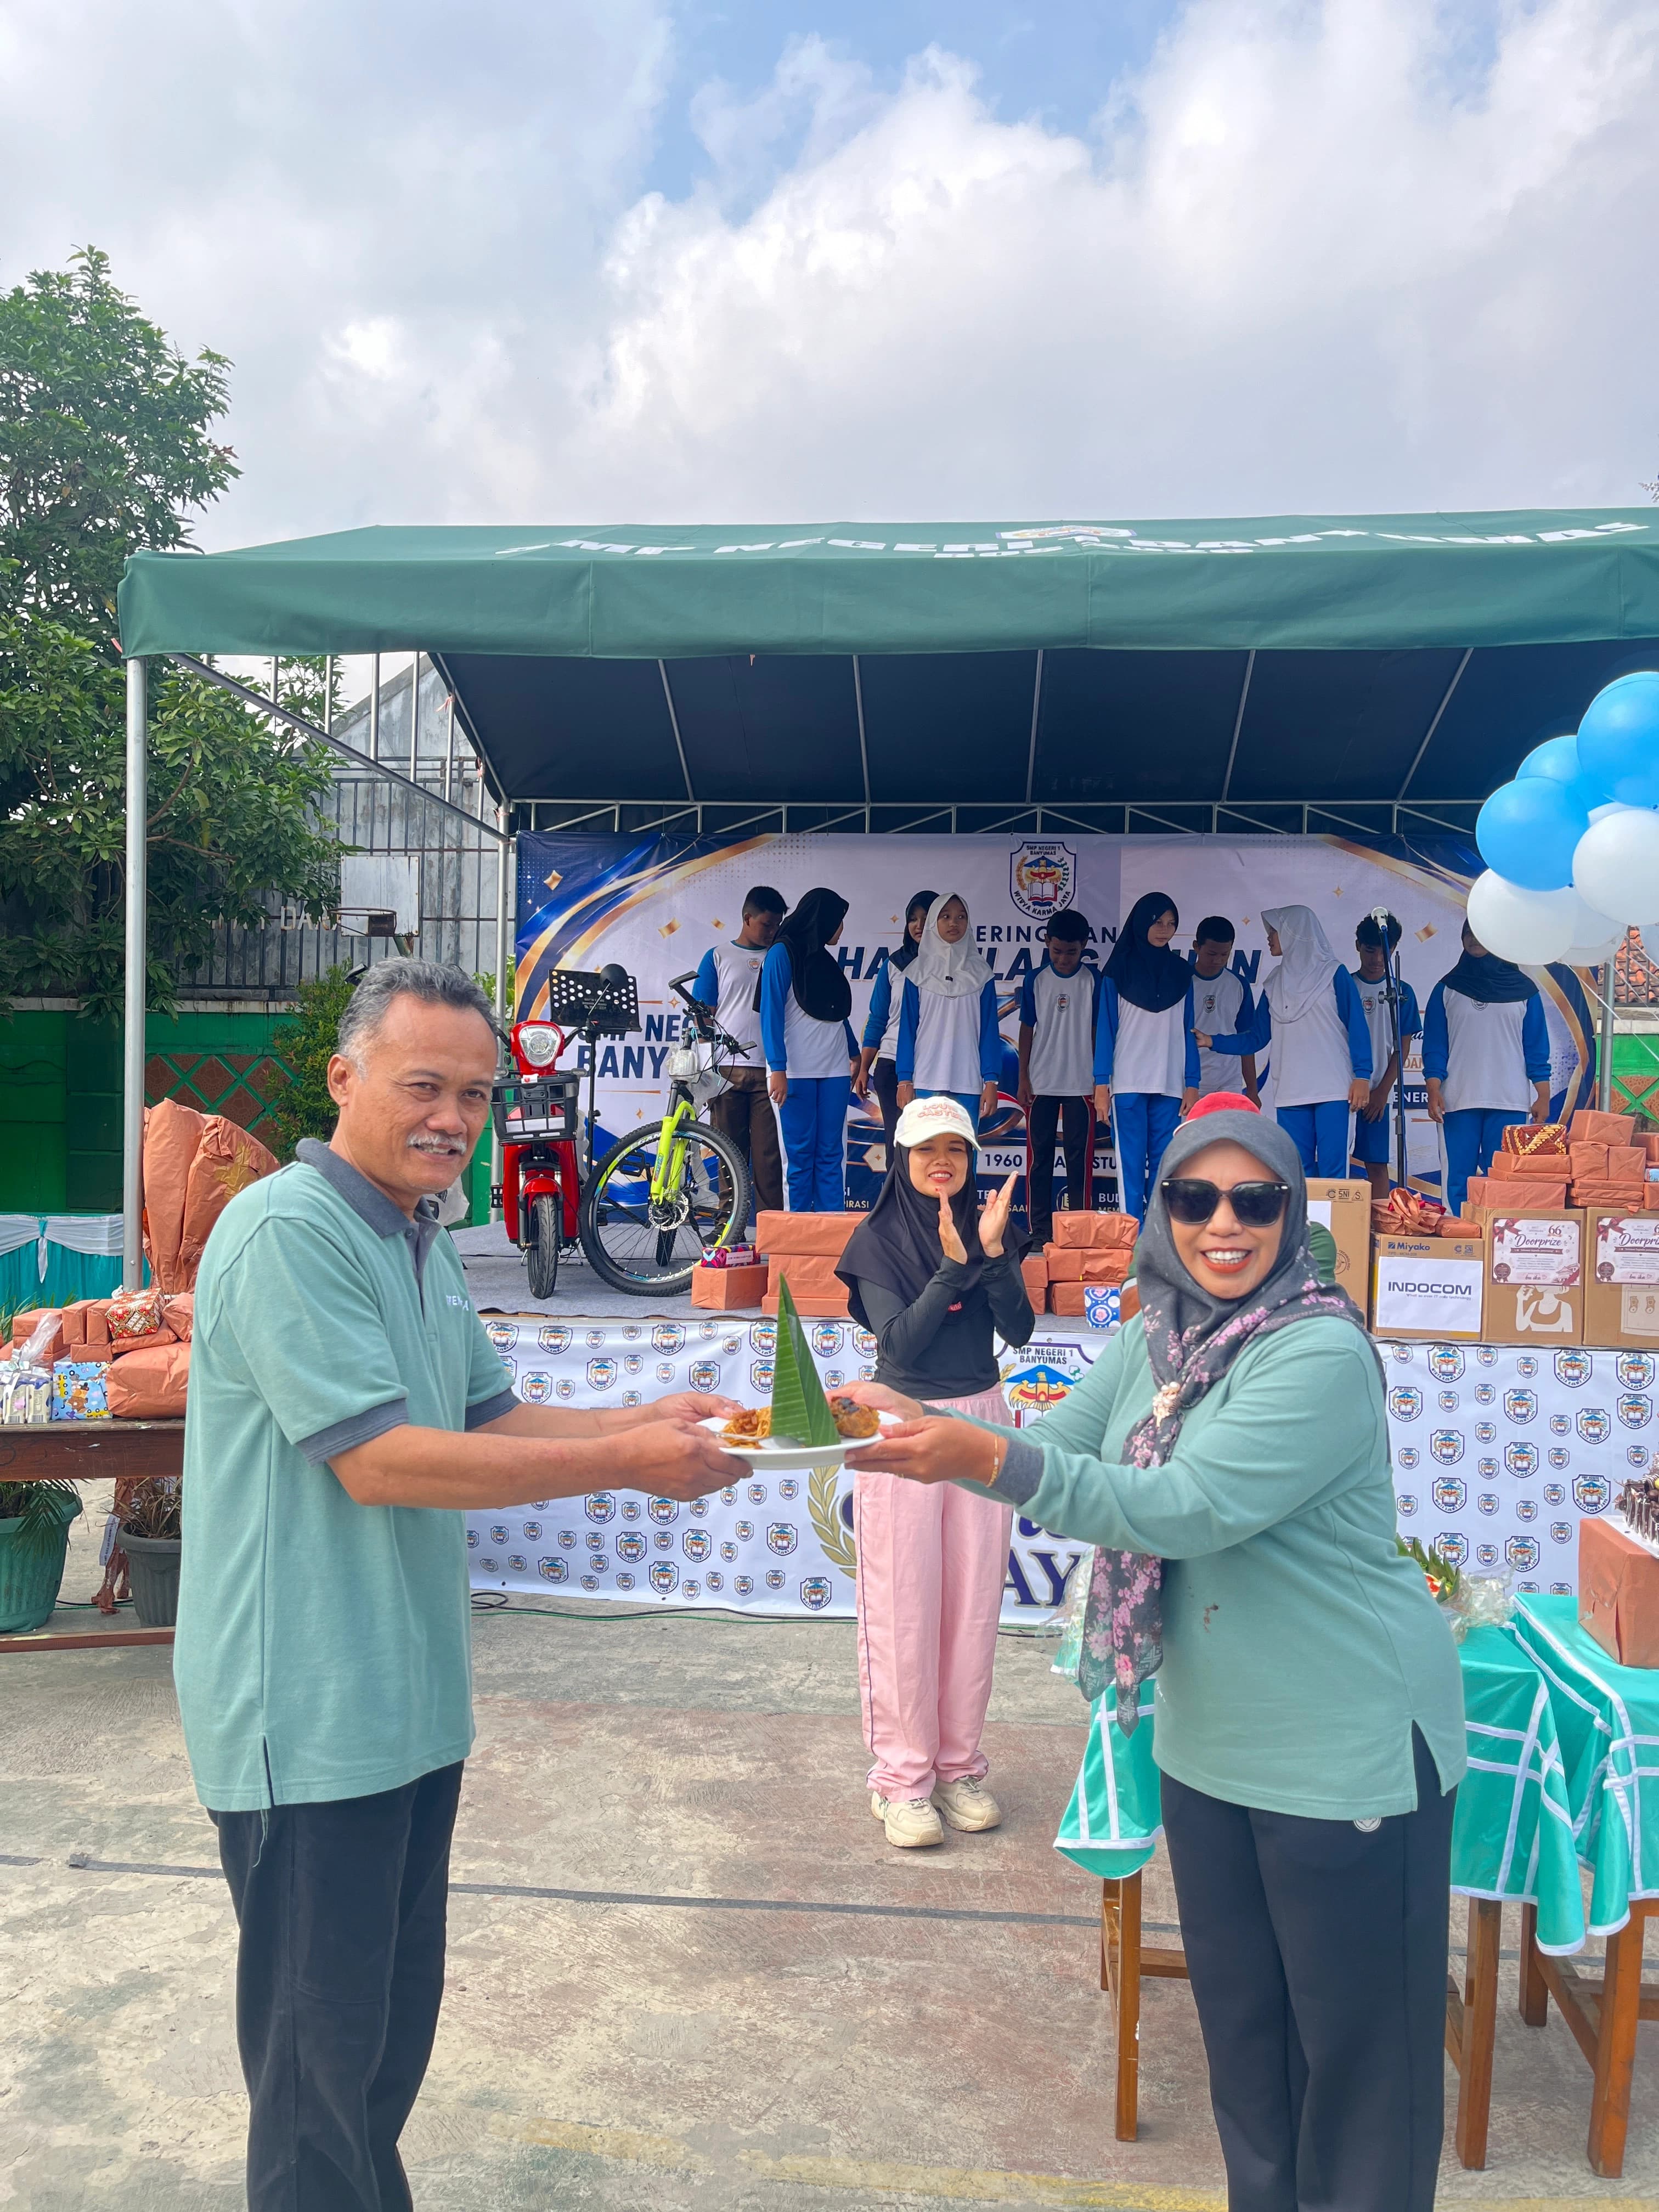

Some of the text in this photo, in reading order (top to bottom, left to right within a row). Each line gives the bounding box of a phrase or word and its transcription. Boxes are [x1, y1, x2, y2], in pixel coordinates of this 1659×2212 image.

[713, 537, 1034, 553] NEGERI
[1127, 522, 1651, 549] BANYUMAS
[1032, 906, 1058, 916] KARMA
[577, 1046, 669, 1079] BANY
[985, 1154, 1023, 1167] 1960
[1548, 1224, 1562, 1235] 66
[1397, 1242, 1431, 1252] Miyako
[1515, 1234, 1561, 1248] Doorprize
[1388, 1282, 1471, 1295] INDOCOM
[1035, 1348, 1066, 1356] NEGERI
[1019, 1356, 1067, 1364] BANYUMAS
